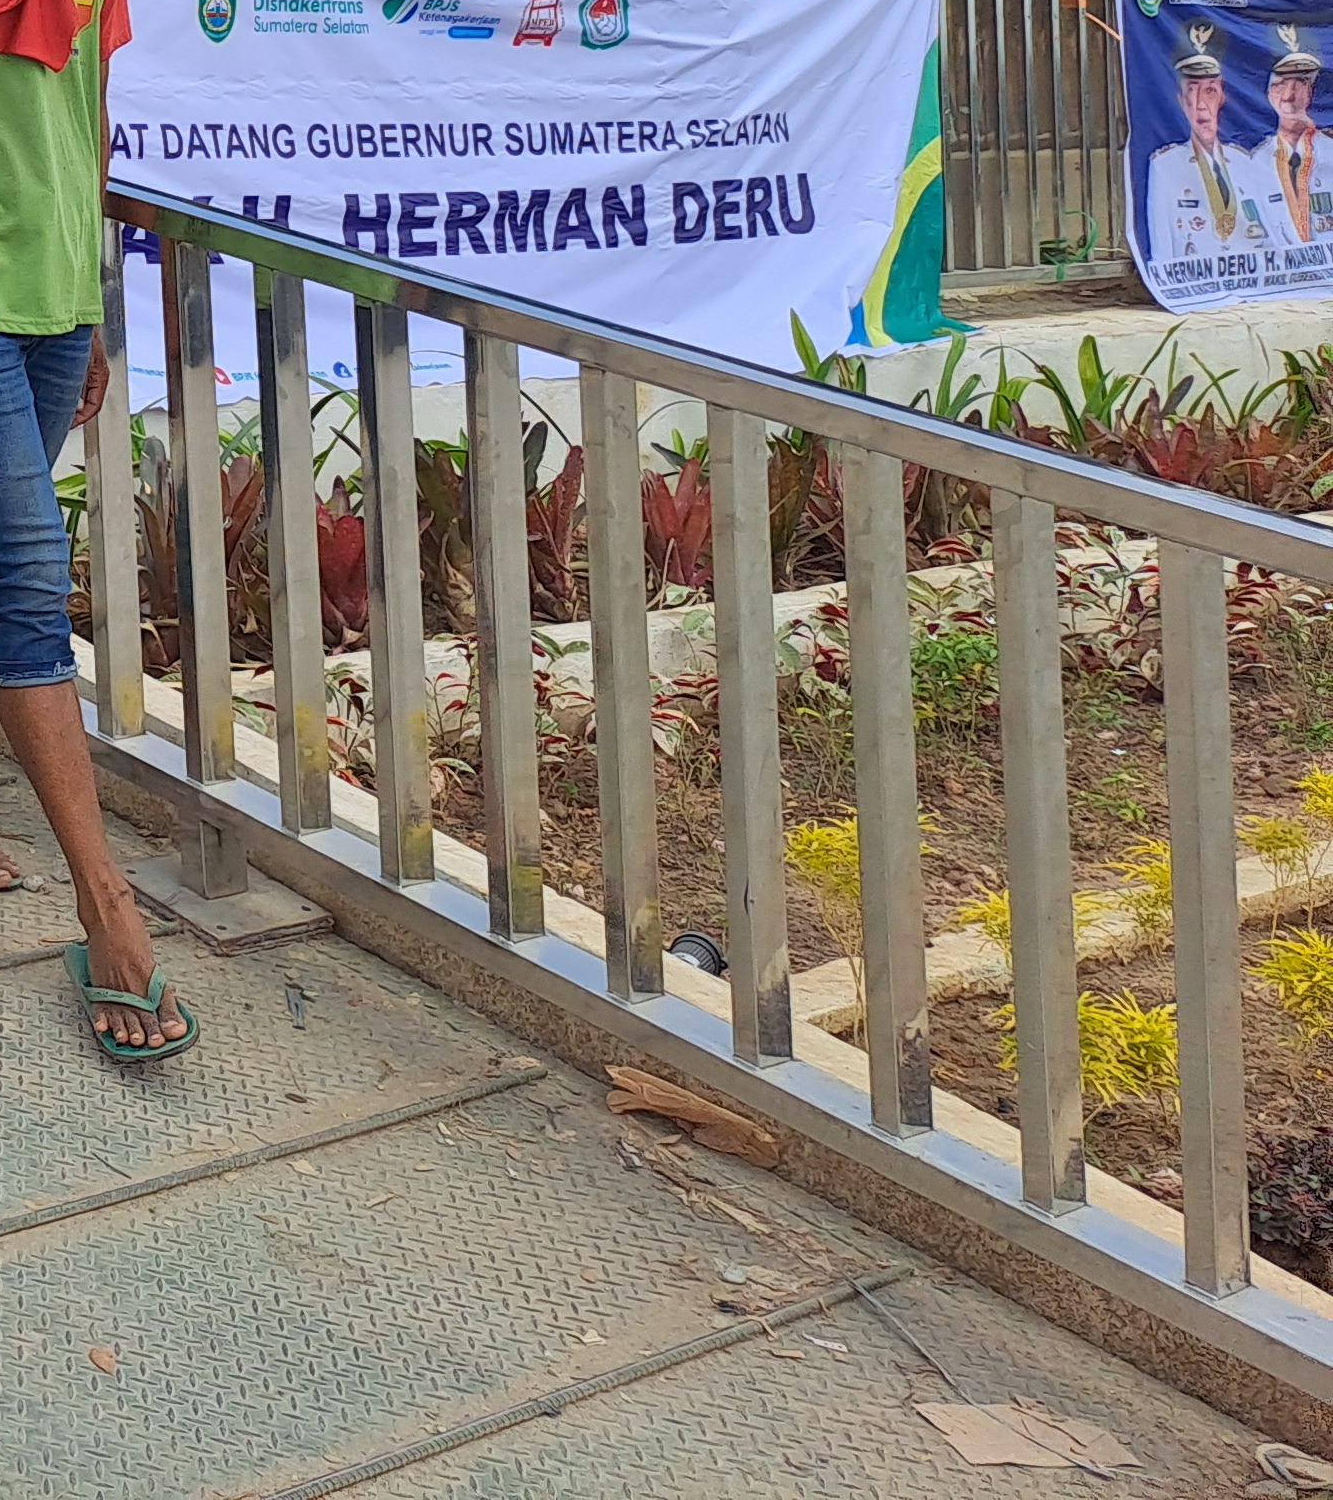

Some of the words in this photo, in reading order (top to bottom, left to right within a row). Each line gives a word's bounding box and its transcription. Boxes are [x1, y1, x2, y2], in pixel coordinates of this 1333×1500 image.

[253, 16, 318, 34] Sumatera
[322, 17, 370, 34] Selatan
[418, 11, 501, 26] Ketenagakerjaan
[110, 122, 148, 160] AT
[162, 122, 296, 160] DATANG
[306, 121, 492, 160] GUBERNUR
[503, 119, 685, 158] SUMATERA
[686, 111, 792, 150] SELATAN
[340, 184, 650, 259] HERMAN
[671, 171, 817, 239] DERU
[1163, 257, 1213, 284] HERMAN
[1217, 252, 1258, 277] DERU
[1264, 250, 1280, 273] H.
